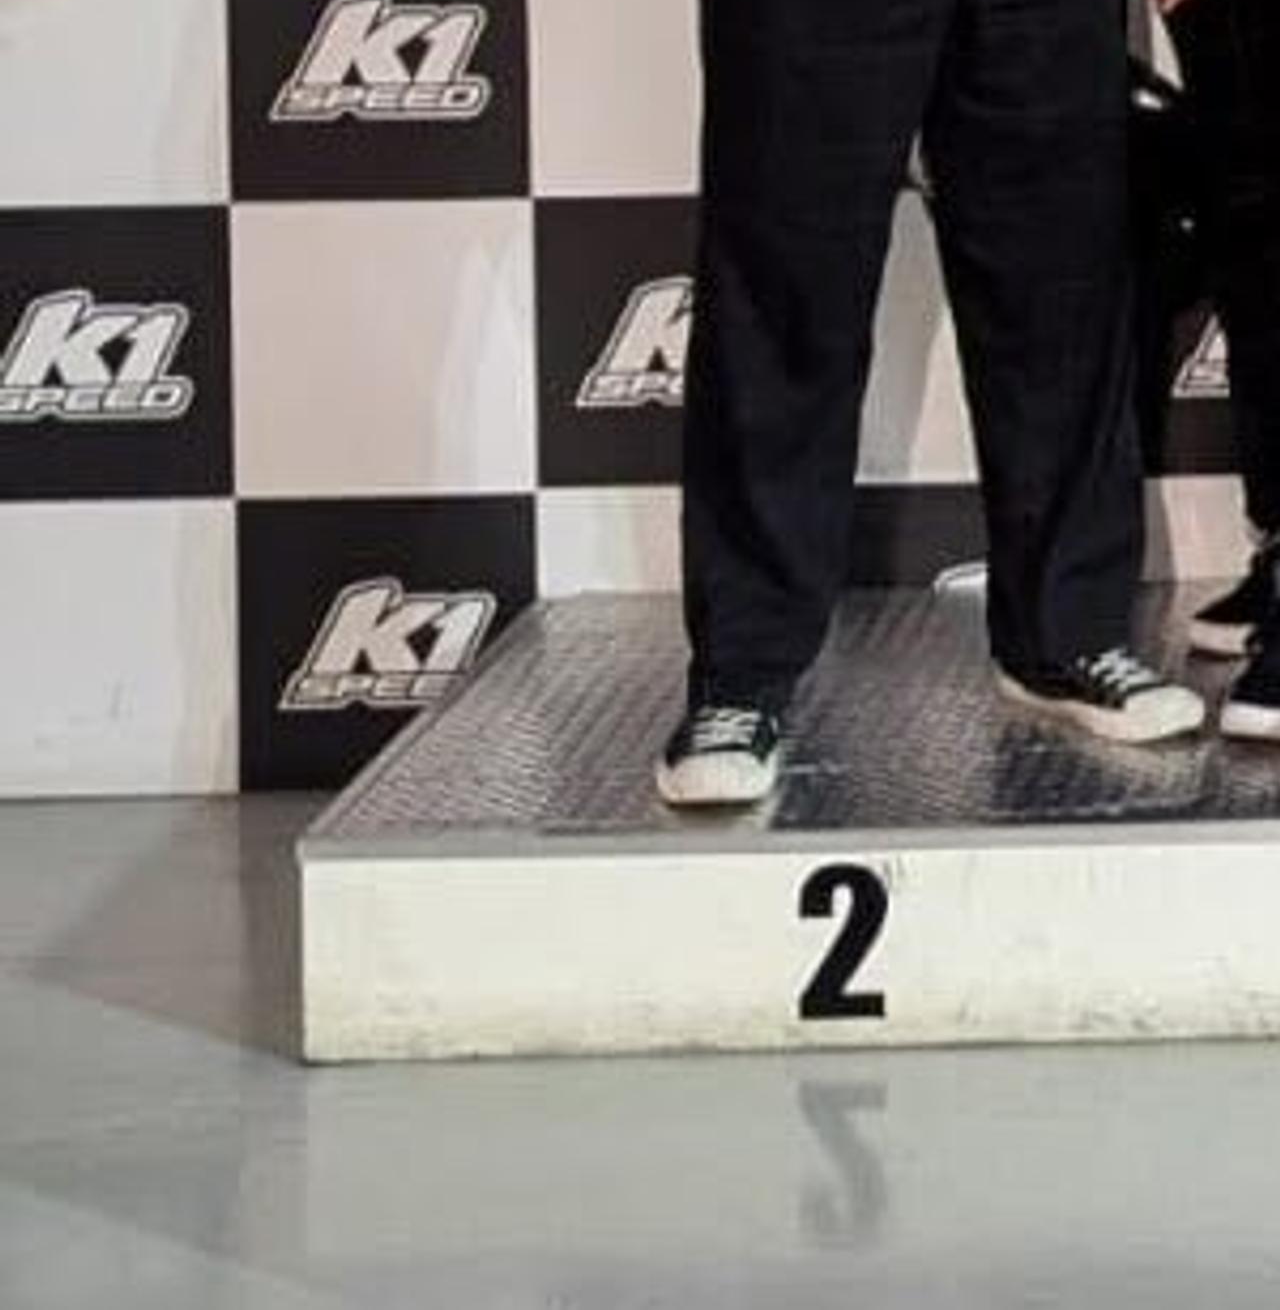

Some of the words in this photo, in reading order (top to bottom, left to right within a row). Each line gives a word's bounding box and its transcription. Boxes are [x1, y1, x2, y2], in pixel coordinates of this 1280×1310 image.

[303, 0, 477, 82] K1
[283, 85, 478, 109] SPEED
[4, 300, 178, 385] K1
[313, 590, 485, 670] K1
[799, 864, 889, 1019] 2
